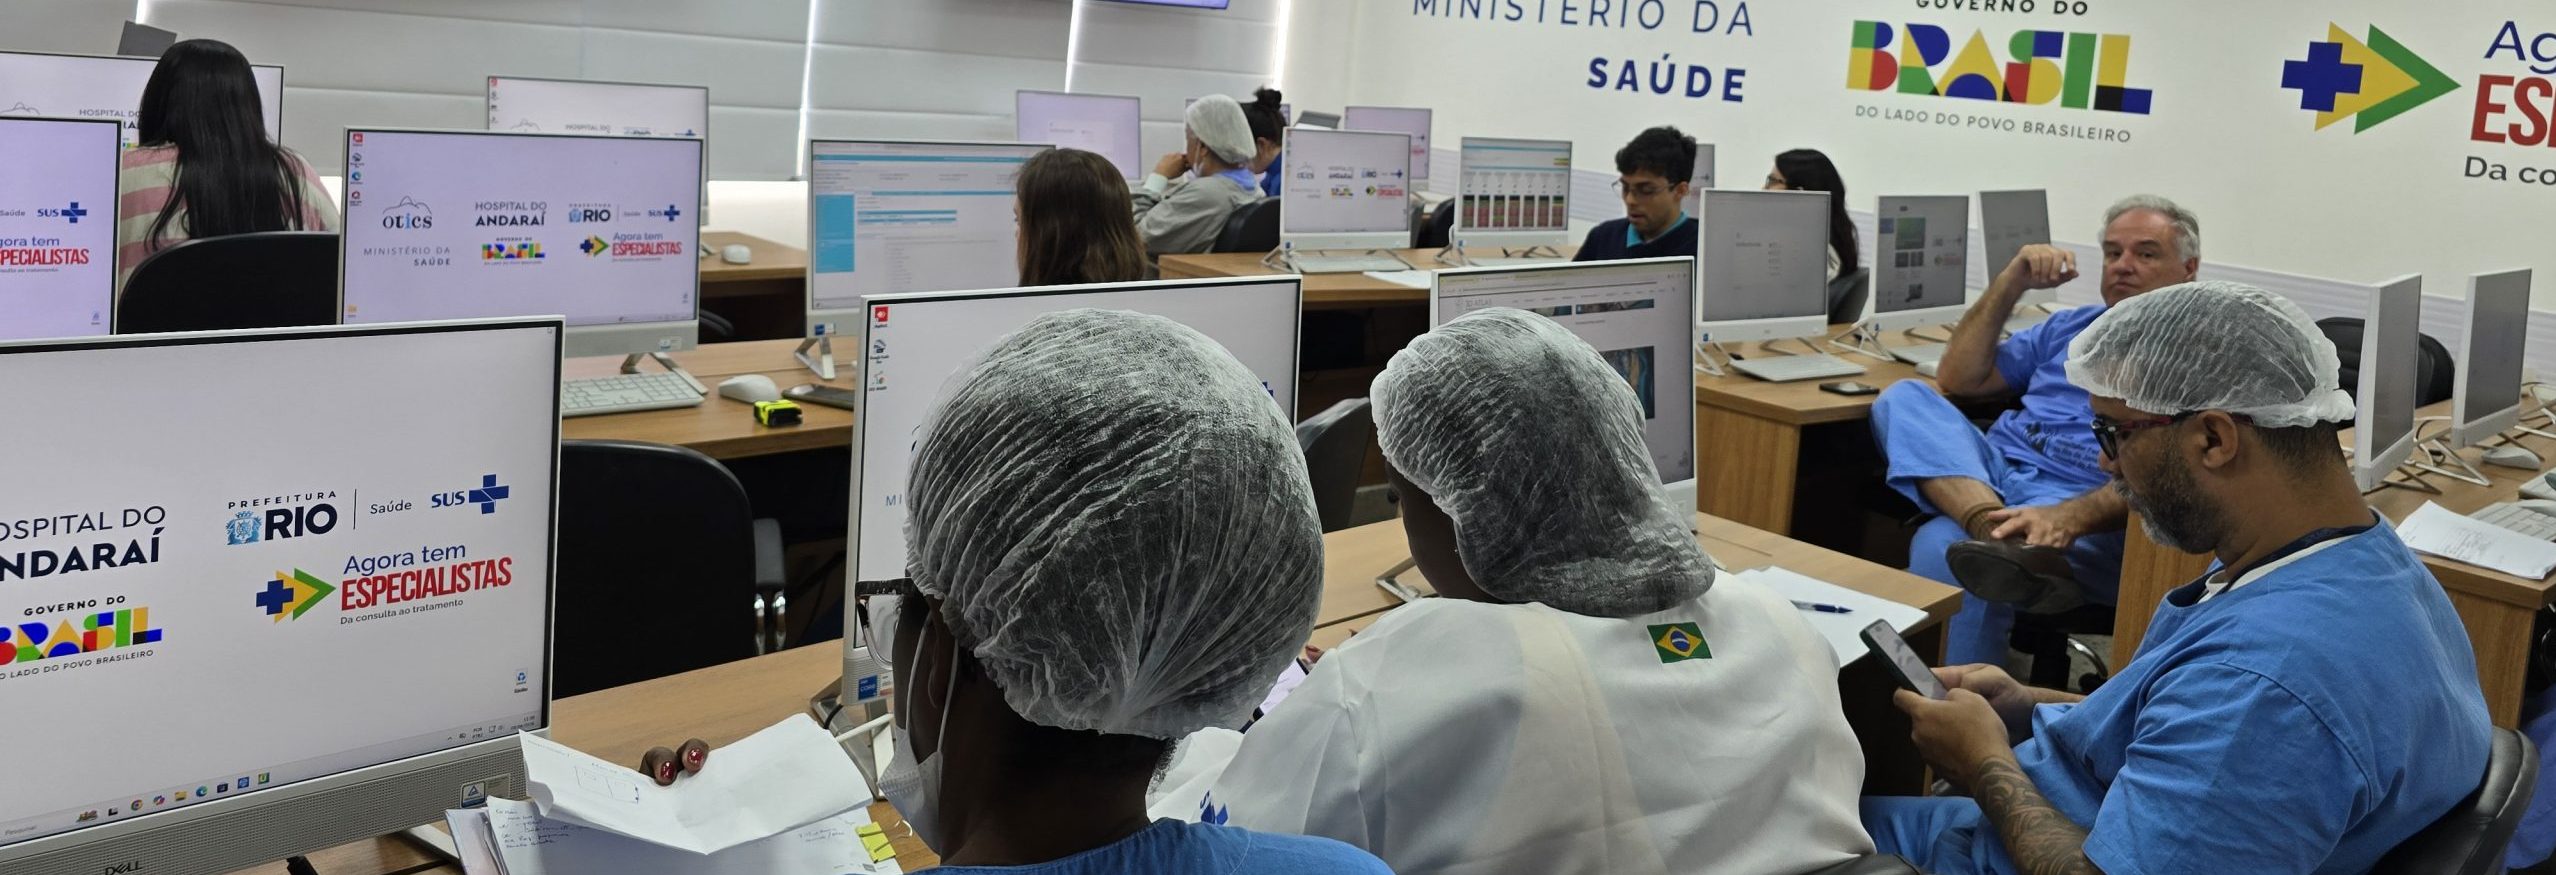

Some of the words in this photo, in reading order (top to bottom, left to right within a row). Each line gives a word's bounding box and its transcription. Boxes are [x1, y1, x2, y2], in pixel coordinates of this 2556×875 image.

[2053, 0, 2088, 16] DO
[1692, 0, 1753, 36] DA
[1846, 19, 2153, 115] BRASIL
[1587, 53, 1746, 103] SAÚDE
[80, 109, 125, 117] HOSPITAL
[2470, 73, 2556, 148] ES
[1855, 105, 1879, 118] DO
[1884, 107, 1929, 123] LADO
[1935, 113, 1960, 126] DO
[1967, 115, 2015, 132] POVO
[2023, 121, 2131, 143] BRASILEIRO
[2464, 155, 2507, 181] Da
[37, 208, 59, 217] SUS
[475, 201, 528, 211] HOSPITAL
[530, 201, 547, 210] DO
[382, 212, 432, 229] otics
[475, 211, 546, 226] ANDARAÍ
[583, 209, 611, 222] RIO
[32, 236, 59, 246] tem
[613, 232, 642, 242] Agora
[644, 232, 663, 240] tem
[363, 246, 431, 256] MINISTÉRIO
[436, 246, 450, 255] DA
[612, 241, 682, 256] ESPECIALISTAS
[414, 257, 450, 266] SAÚDE
[228, 490, 336, 509] PREFEITURA
[370, 500, 412, 515] Saúde
[431, 491, 465, 508] SUS
[122, 505, 166, 528] DO
[265, 503, 338, 541] RIO
[343, 550, 415, 577] Agora
[422, 544, 466, 564] tem
[340, 557, 512, 611] ESPECIALISTAS
[24, 599, 97, 616] GOVERNO
[106, 595, 126, 605] DO
[340, 616, 353, 625] Da
[355, 609, 397, 623] consulta
[398, 607, 410, 616] ao
[412, 599, 464, 614] tratamento
[0, 606, 163, 666] BRASIL
[10, 667, 39, 679] LADO
[43, 664, 59, 673] DO
[63, 659, 92, 670] POVO
[96, 649, 154, 665] BRASILEIRO
[105, 861, 143, 875] DELL
